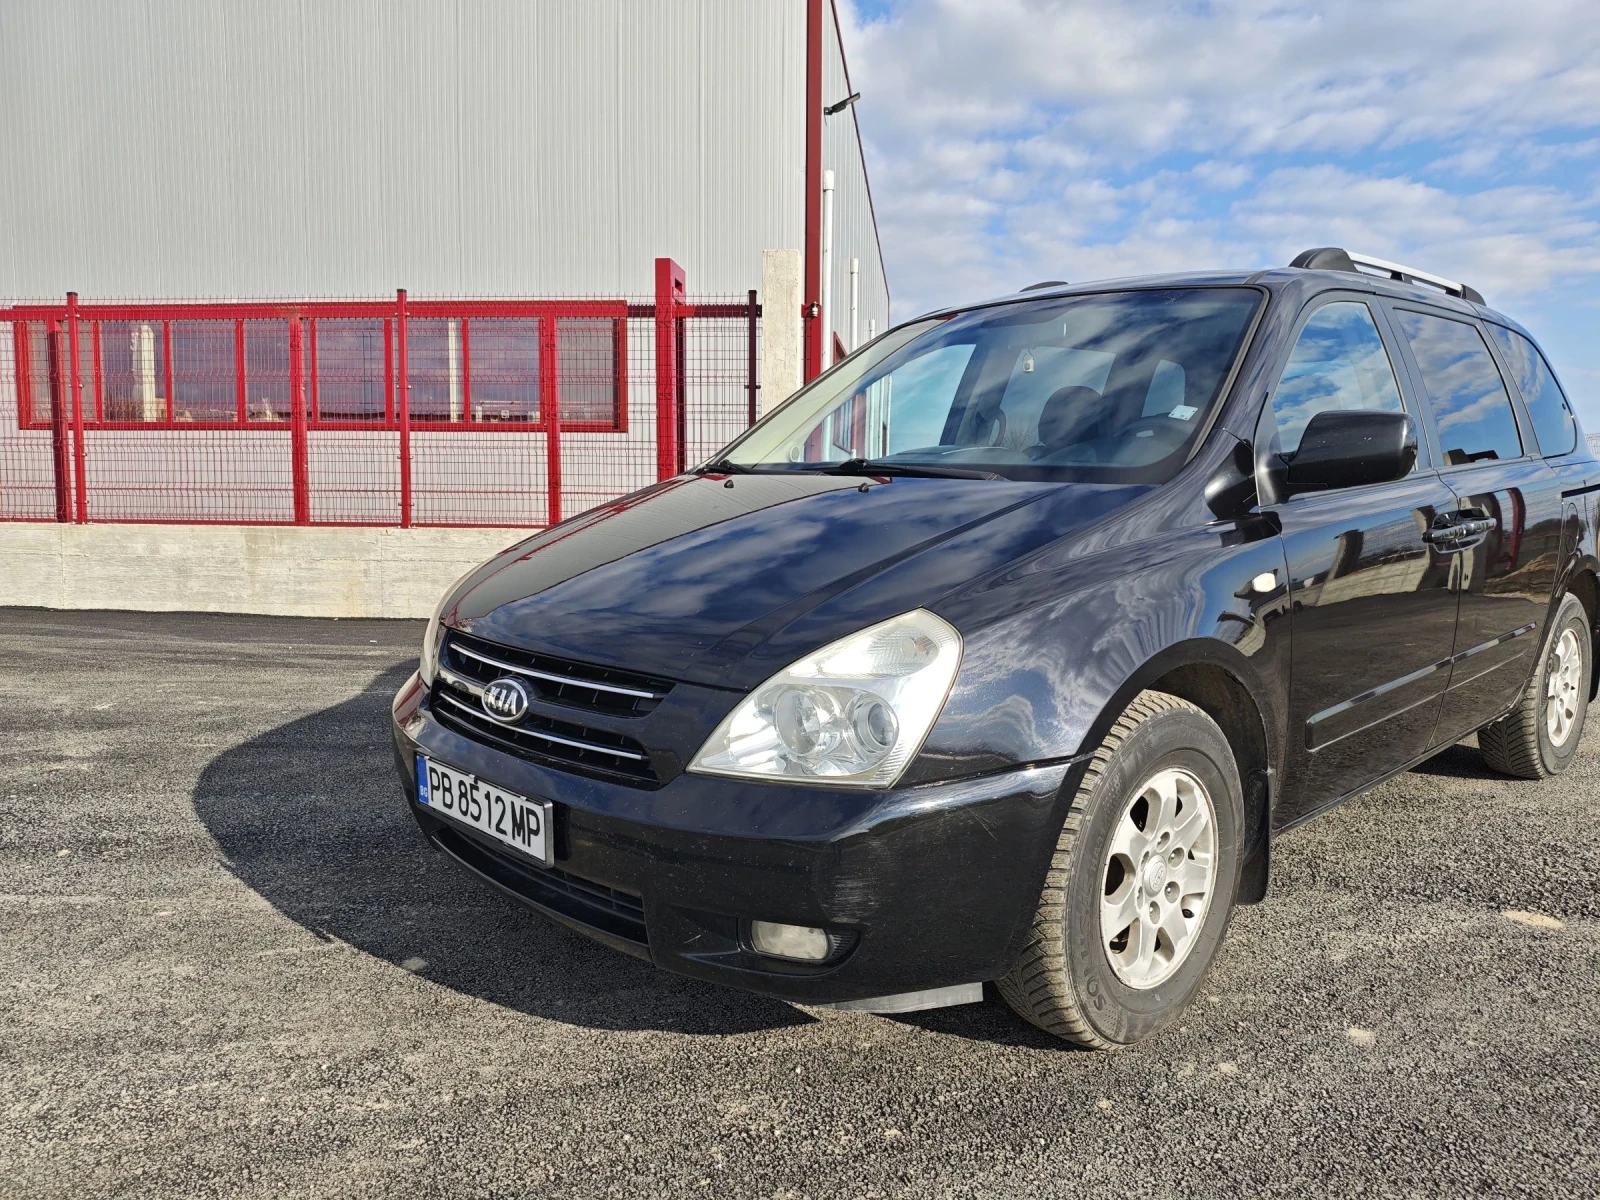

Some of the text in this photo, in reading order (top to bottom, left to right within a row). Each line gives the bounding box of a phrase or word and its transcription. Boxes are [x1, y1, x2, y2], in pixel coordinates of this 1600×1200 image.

[485, 686, 518, 715] KIA
[420, 785, 429, 798] BG
[429, 766, 541, 848] PB 8512 MP
